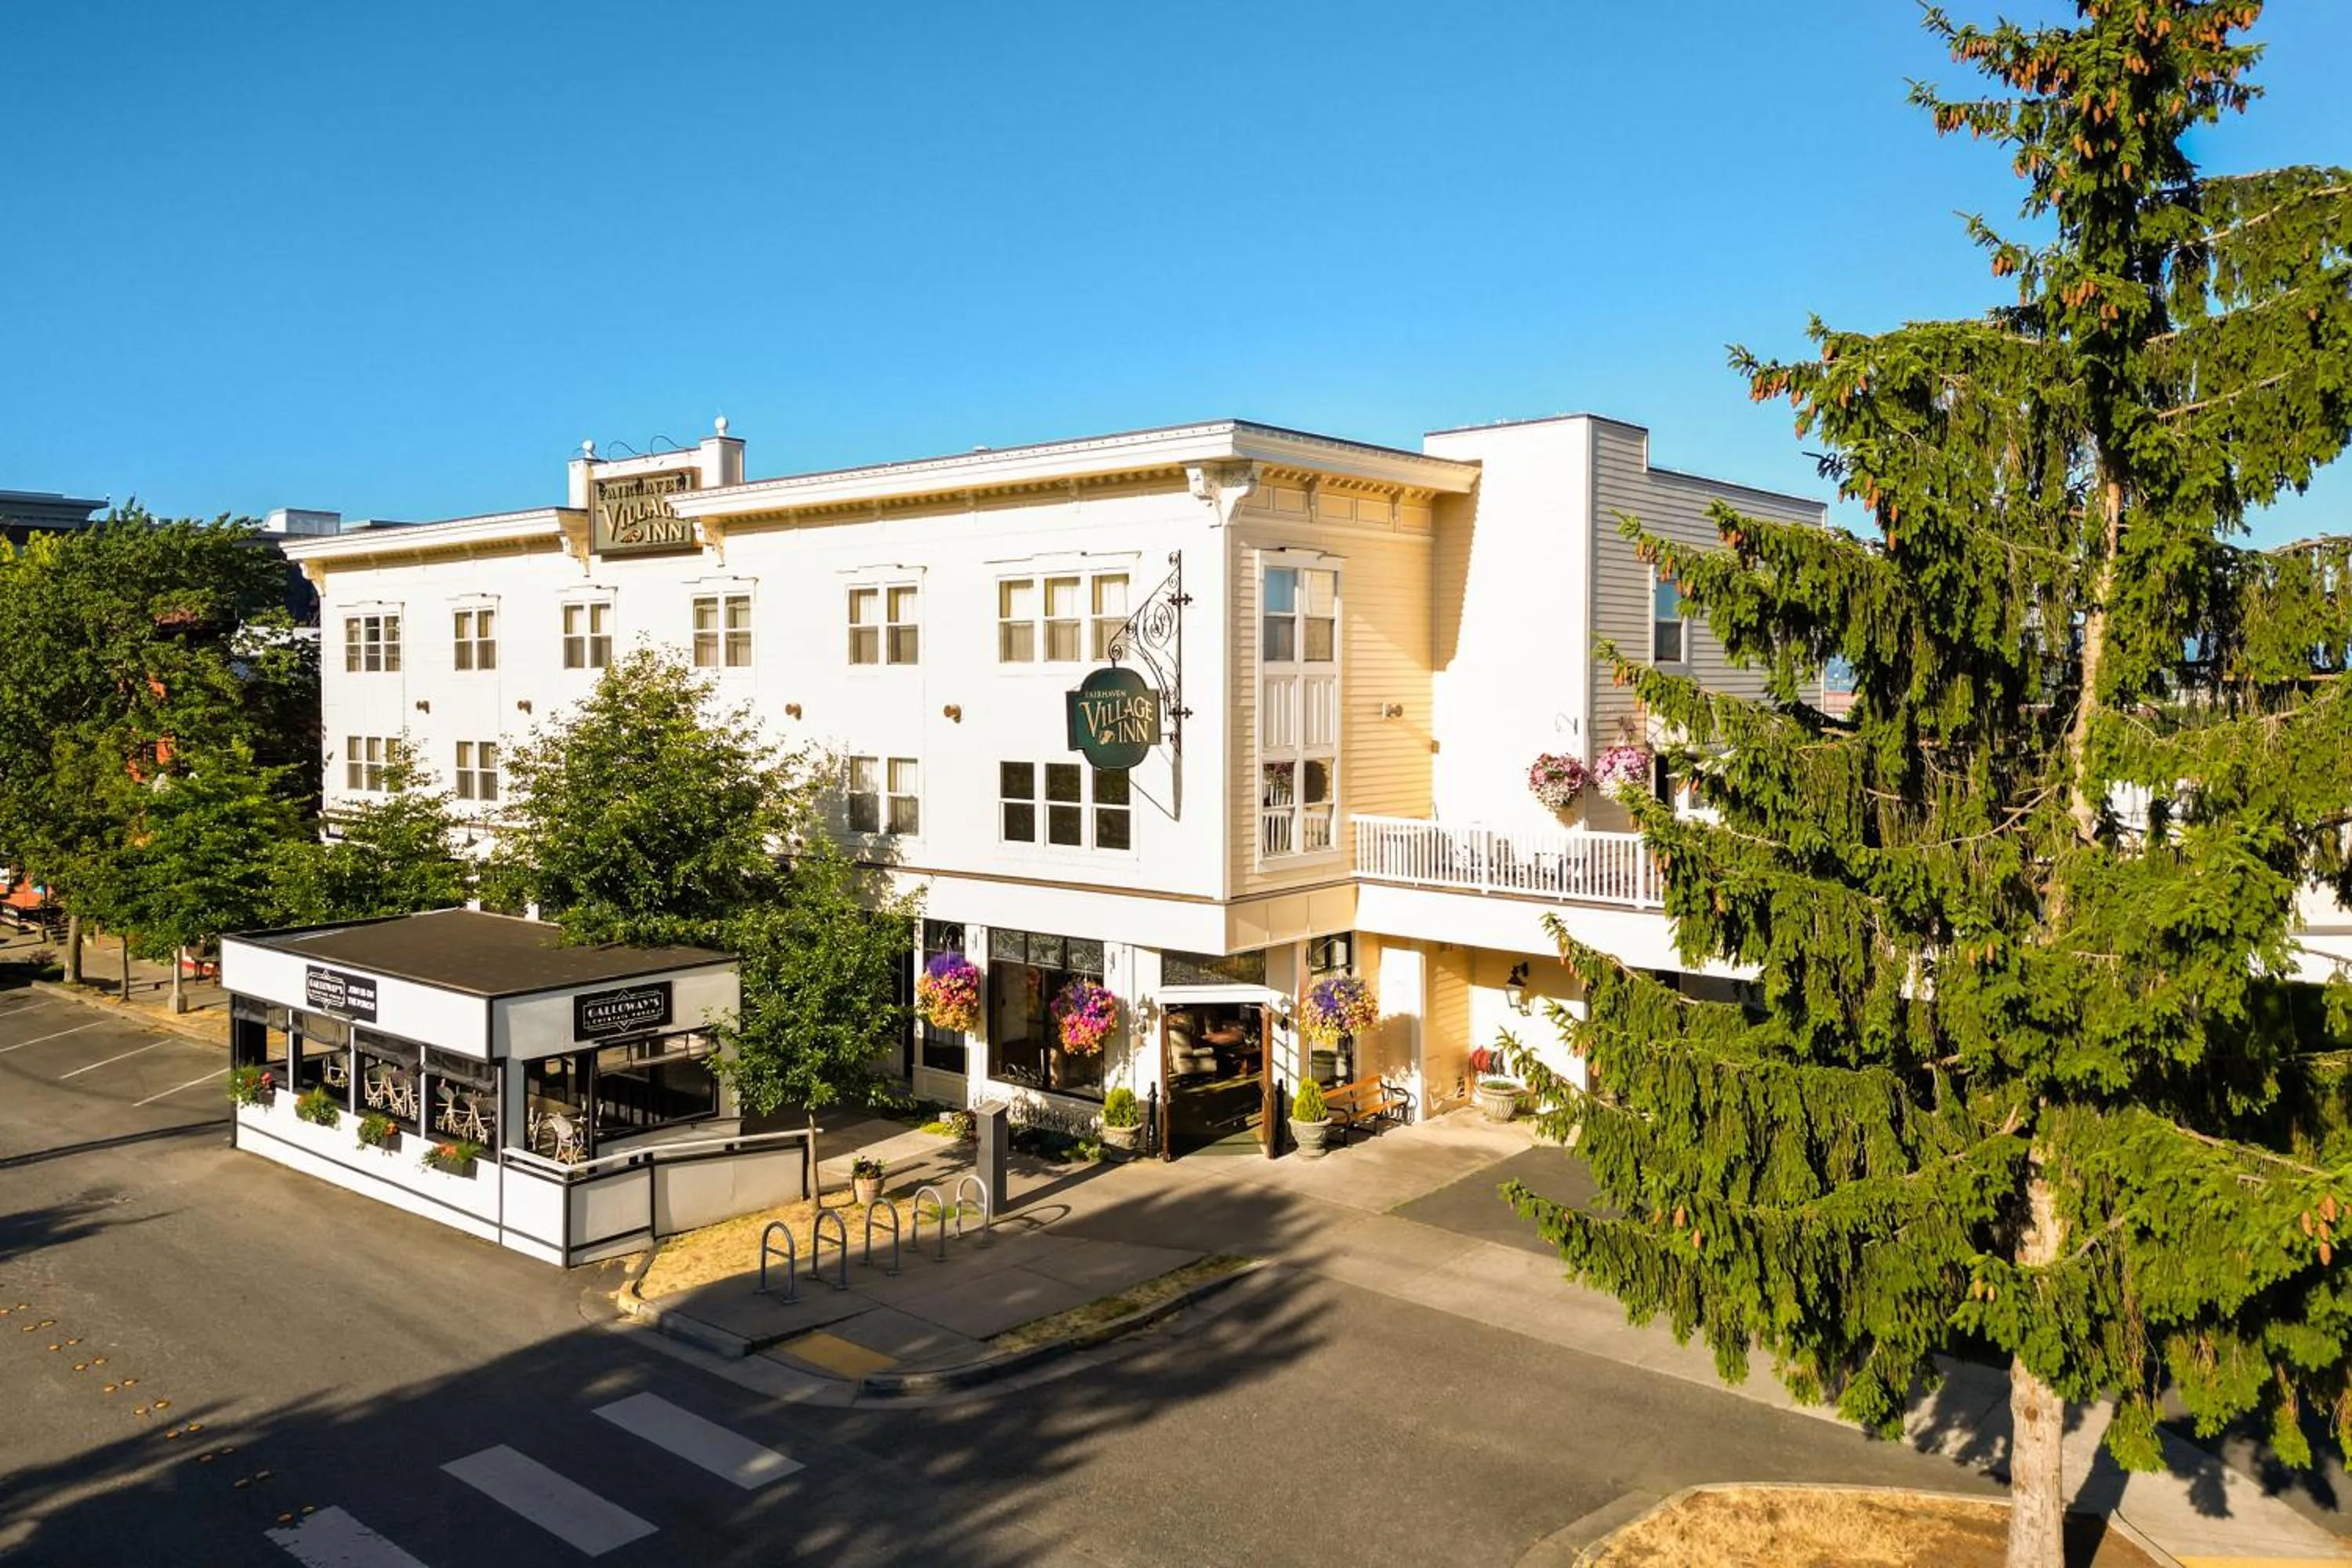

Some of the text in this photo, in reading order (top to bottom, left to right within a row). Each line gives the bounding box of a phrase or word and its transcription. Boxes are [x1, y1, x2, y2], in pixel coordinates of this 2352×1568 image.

[597, 498, 686, 543] VILLAG
[646, 523, 685, 543] INN
[1079, 695, 1154, 738] VILLAGE
[1118, 717, 1149, 743] INN
[587, 999, 659, 1018] GALLOWAY'S
